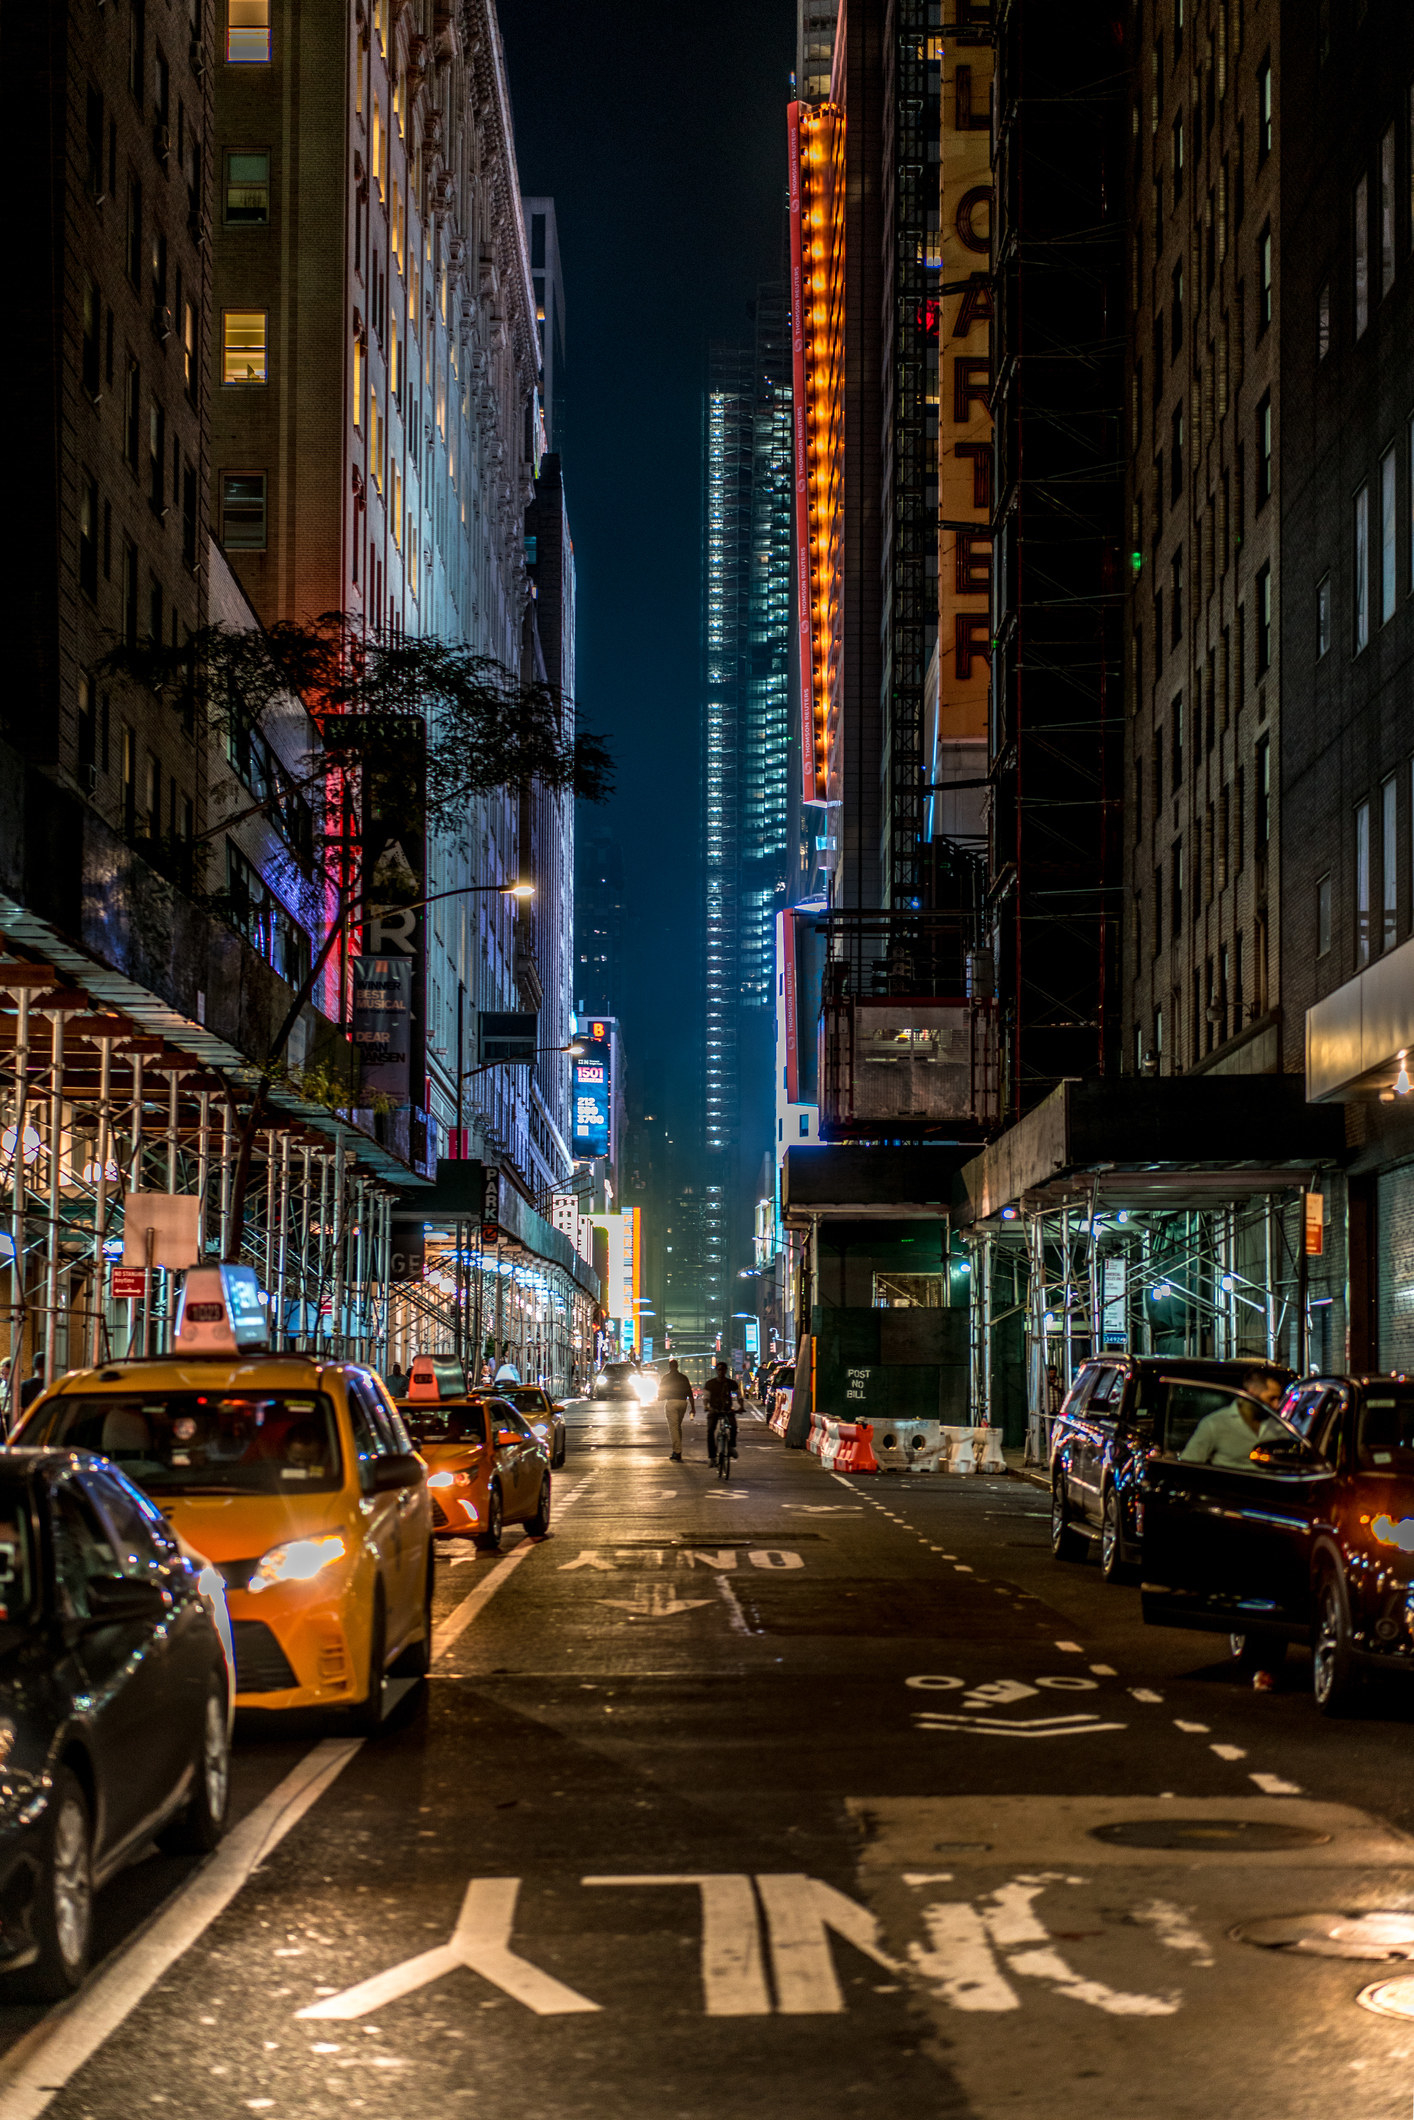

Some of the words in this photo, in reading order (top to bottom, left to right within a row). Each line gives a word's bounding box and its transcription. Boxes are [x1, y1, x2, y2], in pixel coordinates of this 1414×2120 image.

[952, 185, 995, 679] CARTER
[355, 980, 401, 990] WINNER
[356, 990, 386, 999] BEST
[356, 1000, 406, 1010] MUSICAL
[355, 1031, 390, 1043] DEAR
[576, 1066, 604, 1078] 1501
[484, 1168, 498, 1219] PARK
[847, 1369, 871, 1379] POST
[851, 1379, 864, 1388] NO
[846, 1389, 867, 1399] BILL
